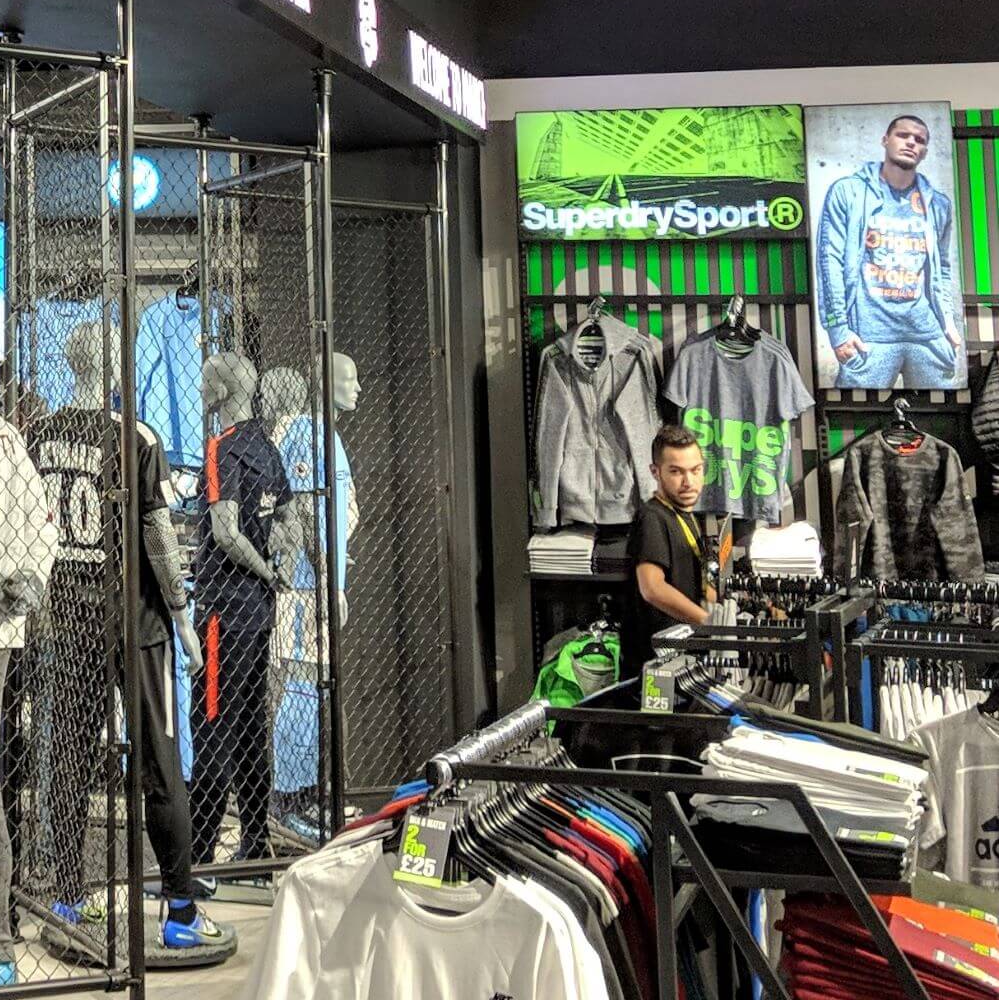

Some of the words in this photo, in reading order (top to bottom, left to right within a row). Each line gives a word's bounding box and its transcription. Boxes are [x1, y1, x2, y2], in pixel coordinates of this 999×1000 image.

[645, 695, 669, 710] £25
[406, 824, 420, 842] 2
[403, 840, 427, 858] FOR
[399, 853, 437, 878] £25
